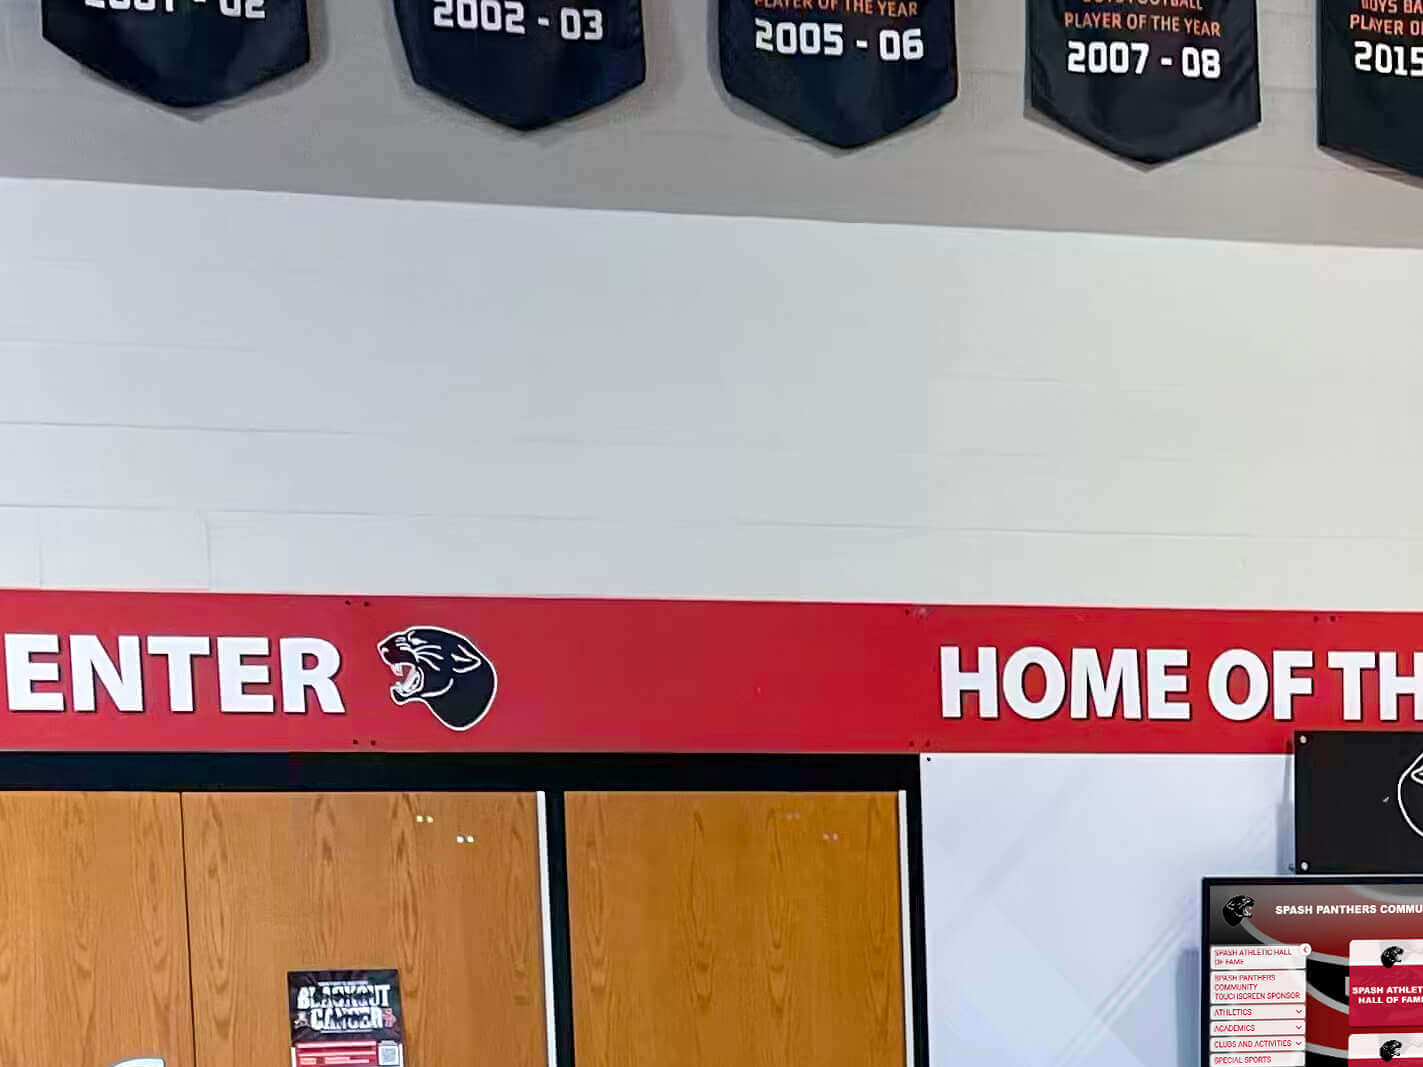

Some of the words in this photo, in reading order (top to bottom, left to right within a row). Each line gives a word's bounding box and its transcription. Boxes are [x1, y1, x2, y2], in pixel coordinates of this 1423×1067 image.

[846, 0, 872, 14] THE
[878, 1, 918, 17] YEAR
[434, 0, 525, 34] 2002
[538, 16, 550, 26] -
[560, 8, 603, 40] 03
[1064, 12, 1122, 29] PLAYER
[1127, 14, 1146, 30] OF
[1151, 16, 1181, 32] THE
[1184, 18, 1221, 37] YEAR
[1350, 14, 1403, 36] PLAYER
[755, 18, 844, 56] 2005
[856, 40, 868, 48] -
[879, 28, 924, 60] 06
[1068, 40, 1149, 74] 2007
[1161, 57, 1172, 66] -
[1182, 47, 1220, 78] 08
[4, 633, 344, 712] ENTER
[939, 645, 1190, 720] HOME
[1207, 648, 1314, 721] OF
[1275, 905, 1313, 914] SPASH
[1316, 904, 1376, 914] PANTHERS
[1352, 986, 1383, 995] SPASH
[1358, 996, 1383, 1004] HALL
[1386, 996, 1399, 1004] OF
[1214, 1008, 1252, 1016] ATHLETICS
[1214, 1024, 1255, 1032] ACADEMICS
[1214, 1040, 1237, 1048] CLUBS
[1254, 1039, 1292, 1047] ACTIVITIES
[1214, 1056, 1243, 1064] SPECIAL
